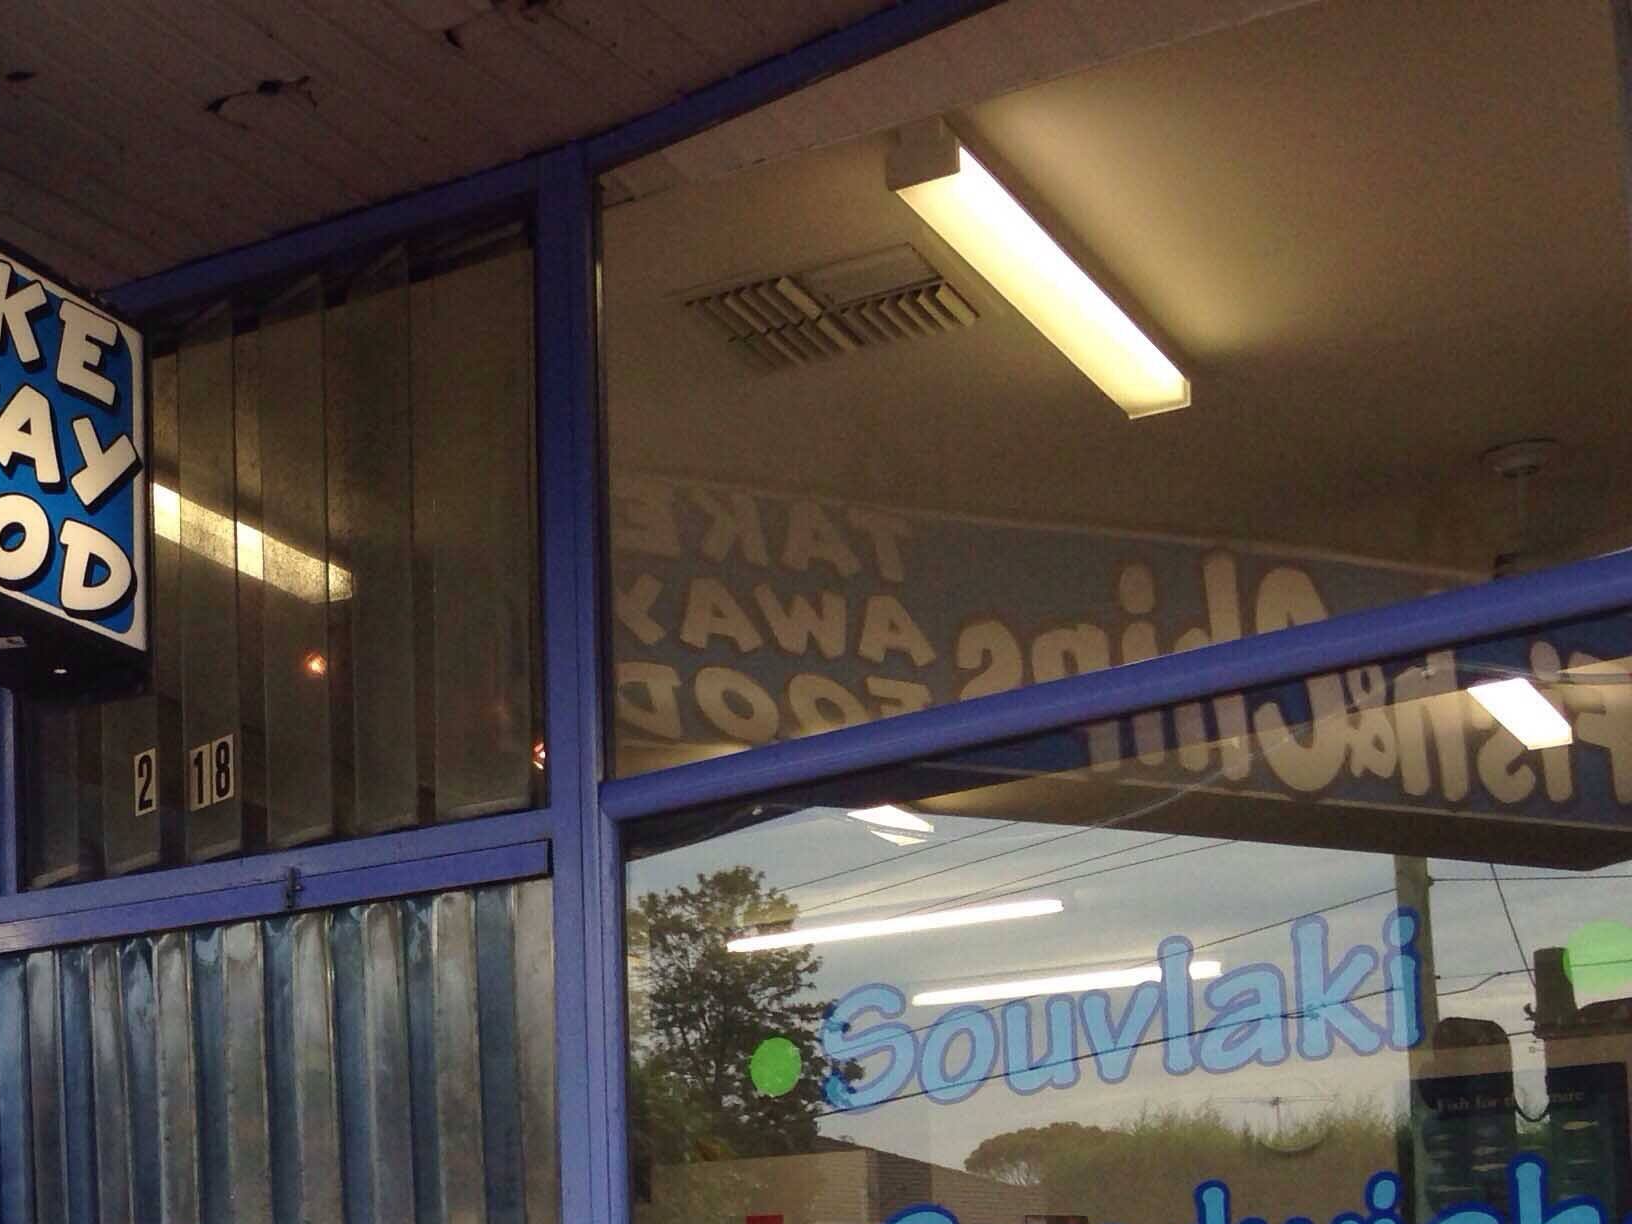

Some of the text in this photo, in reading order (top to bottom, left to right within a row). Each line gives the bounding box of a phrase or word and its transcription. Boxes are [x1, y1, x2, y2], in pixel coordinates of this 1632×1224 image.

[137, 741, 231, 812] 2 18
[818, 905, 1426, 1113] Souvlaki
